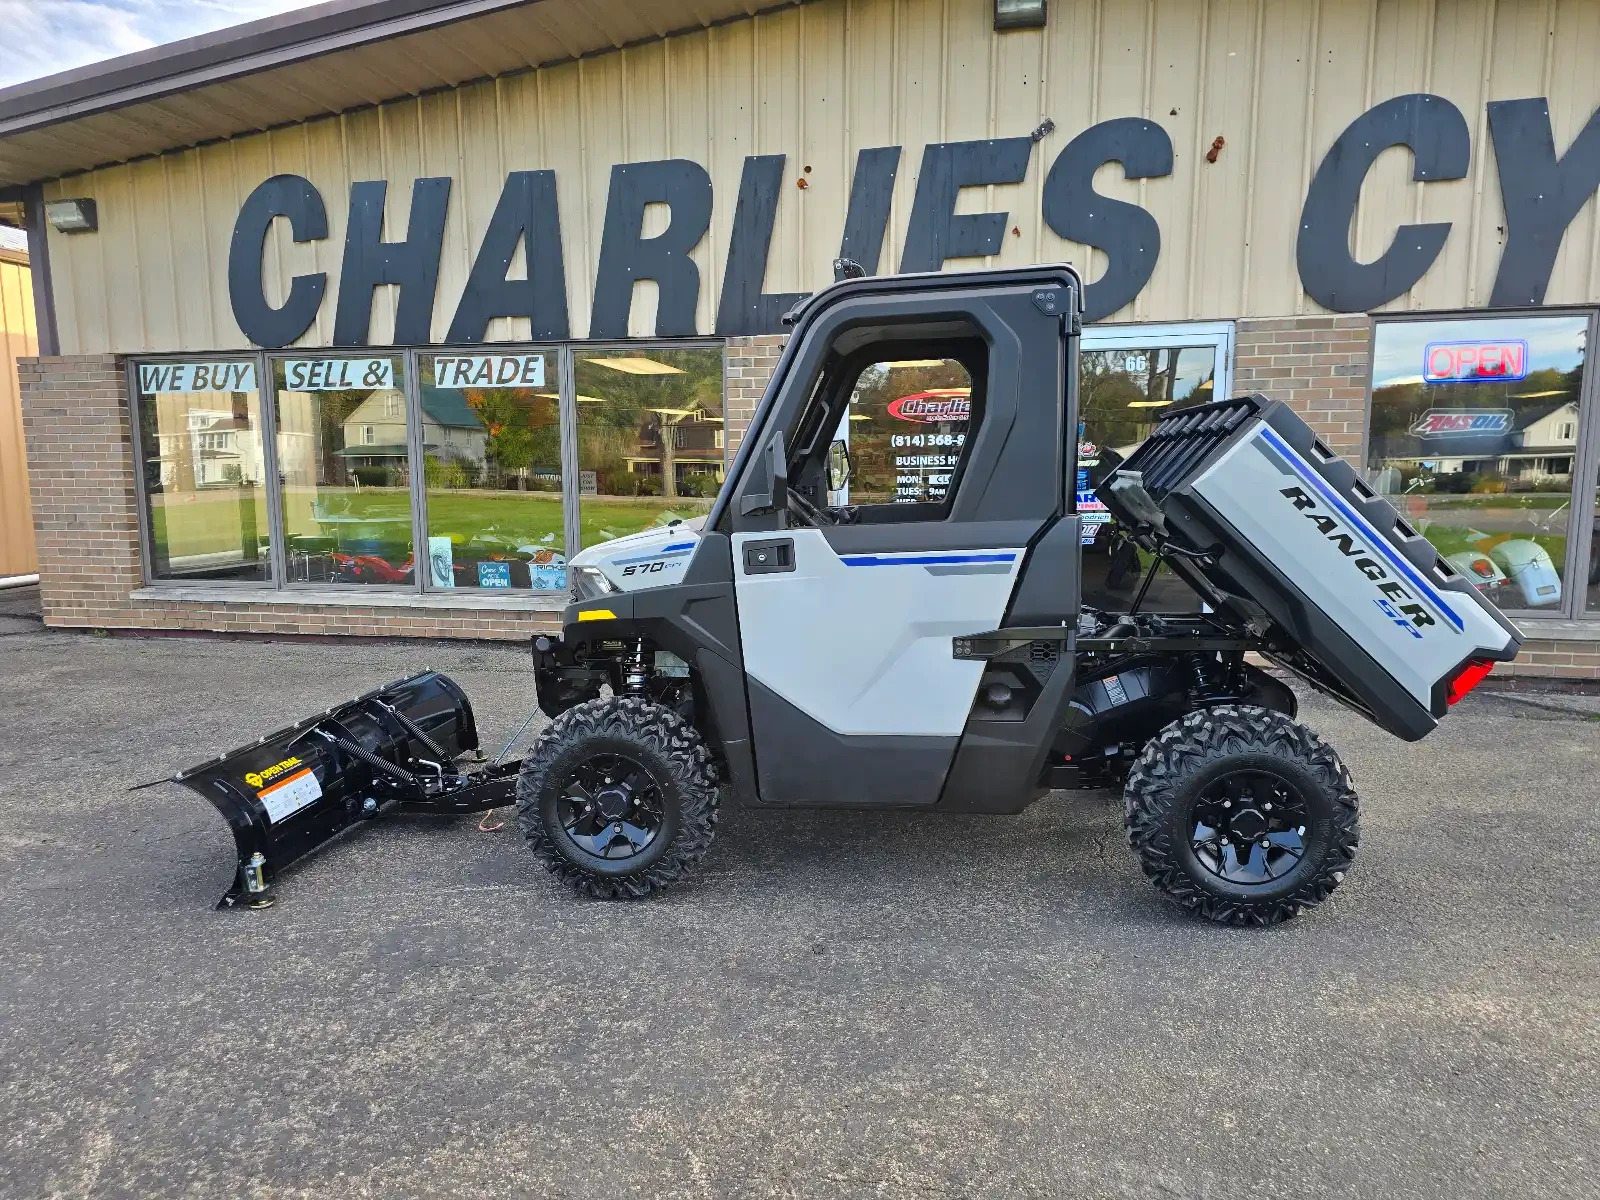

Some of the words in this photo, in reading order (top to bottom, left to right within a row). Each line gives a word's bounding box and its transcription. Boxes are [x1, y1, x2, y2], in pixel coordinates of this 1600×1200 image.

[228, 116, 1173, 348] CHARLIES
[436, 356, 540, 385] TRADE
[1125, 355, 1147, 372] 66
[1428, 346, 1524, 377] OPEN
[142, 365, 185, 392] WE
[191, 364, 251, 391] BUY
[289, 361, 353, 388] SELL
[362, 360, 389, 387] &
[1415, 413, 1509, 434] AMSOIL
[891, 434, 925, 448] (814)
[895, 455, 946, 466] BUSINESS
[896, 475, 922, 484] MON:
[896, 487, 922, 495] TUES:
[1279, 486, 1436, 628] RANGER
[622, 562, 665, 576] 570
[481, 578, 508, 587] OPEN
[1372, 599, 1424, 639] SP
[259, 764, 284, 779] OPEN
[278, 756, 303, 770] TRAIL
